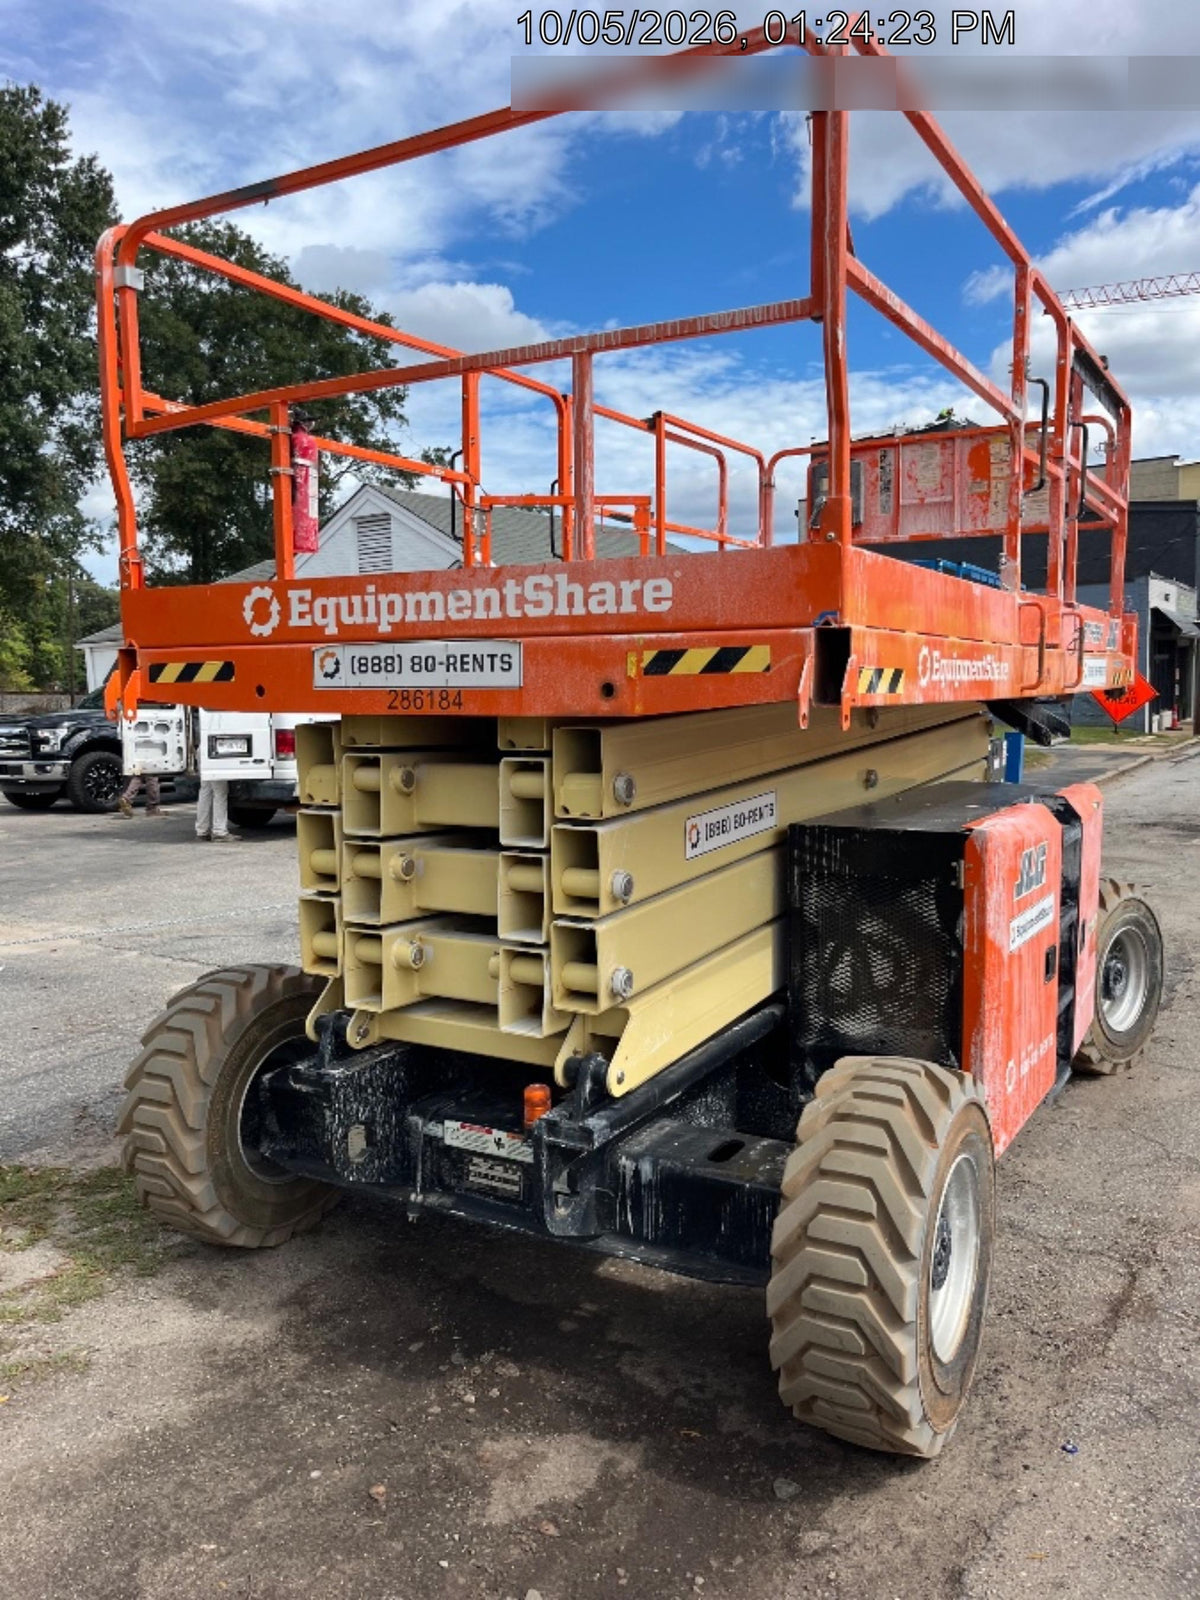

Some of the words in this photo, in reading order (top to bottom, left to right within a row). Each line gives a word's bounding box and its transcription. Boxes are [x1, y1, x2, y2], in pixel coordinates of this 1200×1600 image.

[287, 573, 673, 635] EquipmentShare
[410, 653, 513, 673] 80-RENTS
[387, 689, 463, 710] 286184
